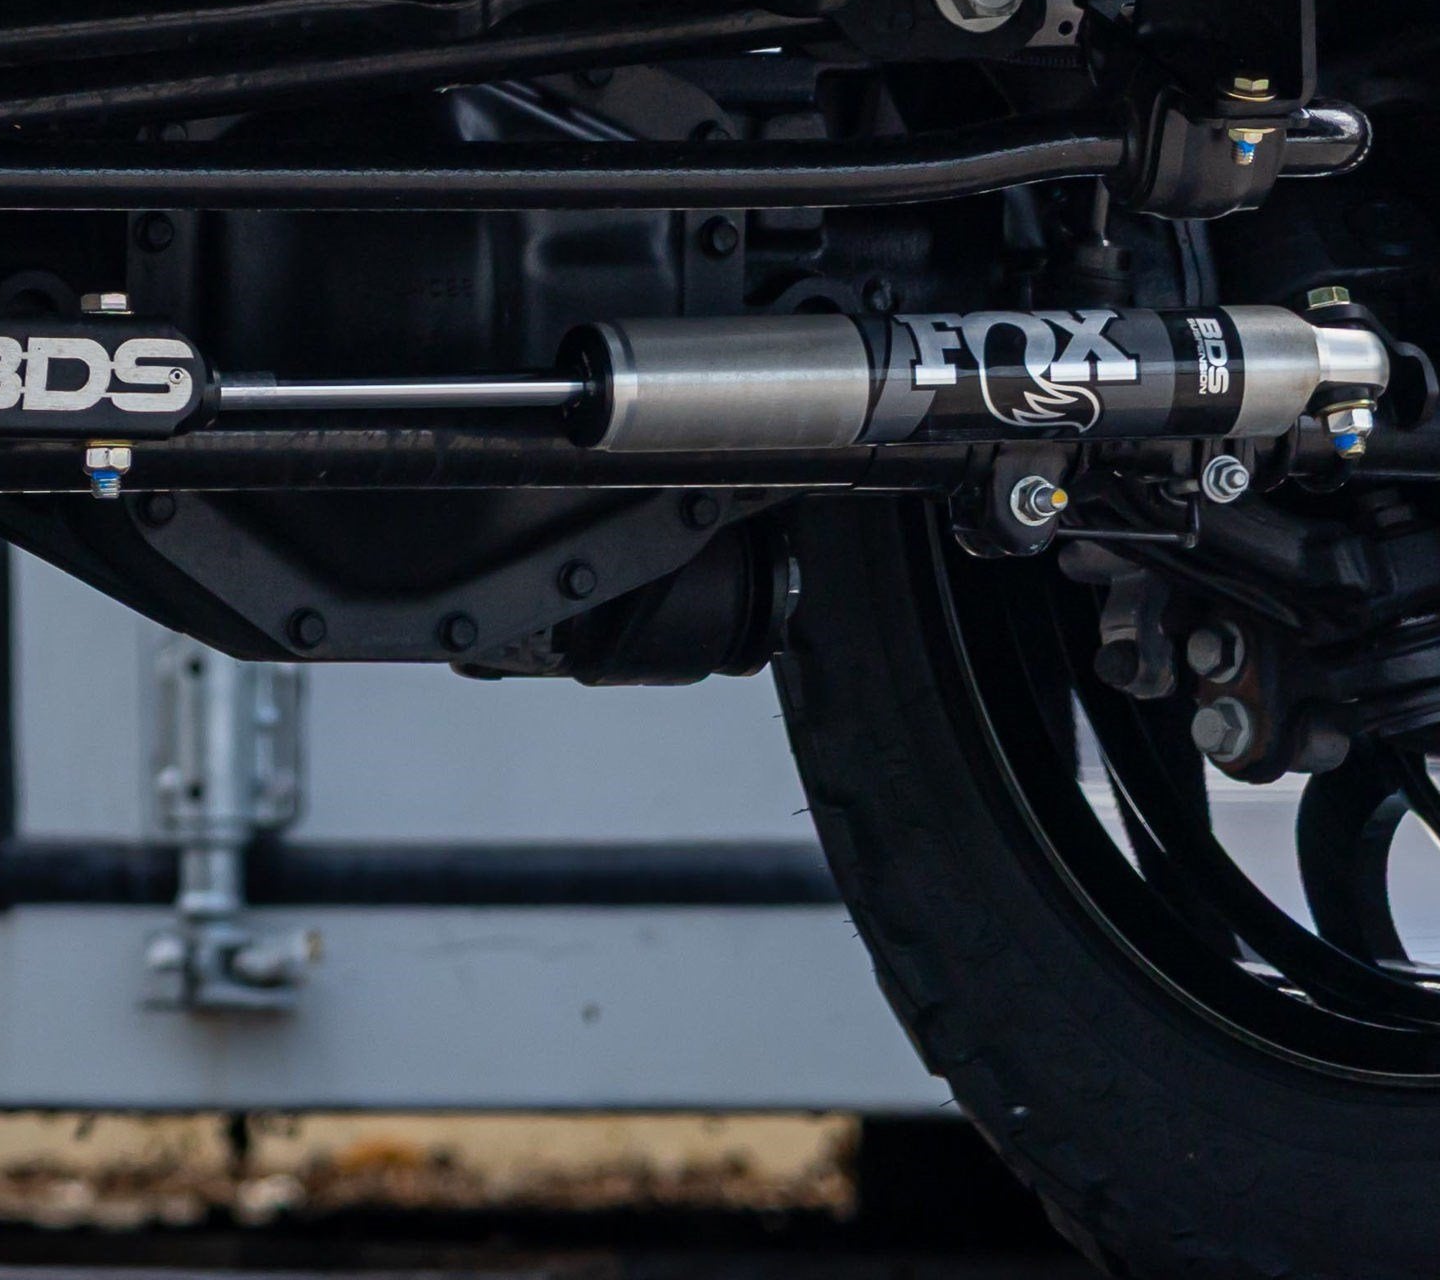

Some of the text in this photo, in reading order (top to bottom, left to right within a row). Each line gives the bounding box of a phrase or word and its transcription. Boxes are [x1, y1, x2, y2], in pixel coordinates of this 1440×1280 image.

[894, 309, 1140, 433] FOX
[1187, 318, 1208, 395] SUSPENSION
[1196, 317, 1230, 394] BDS
